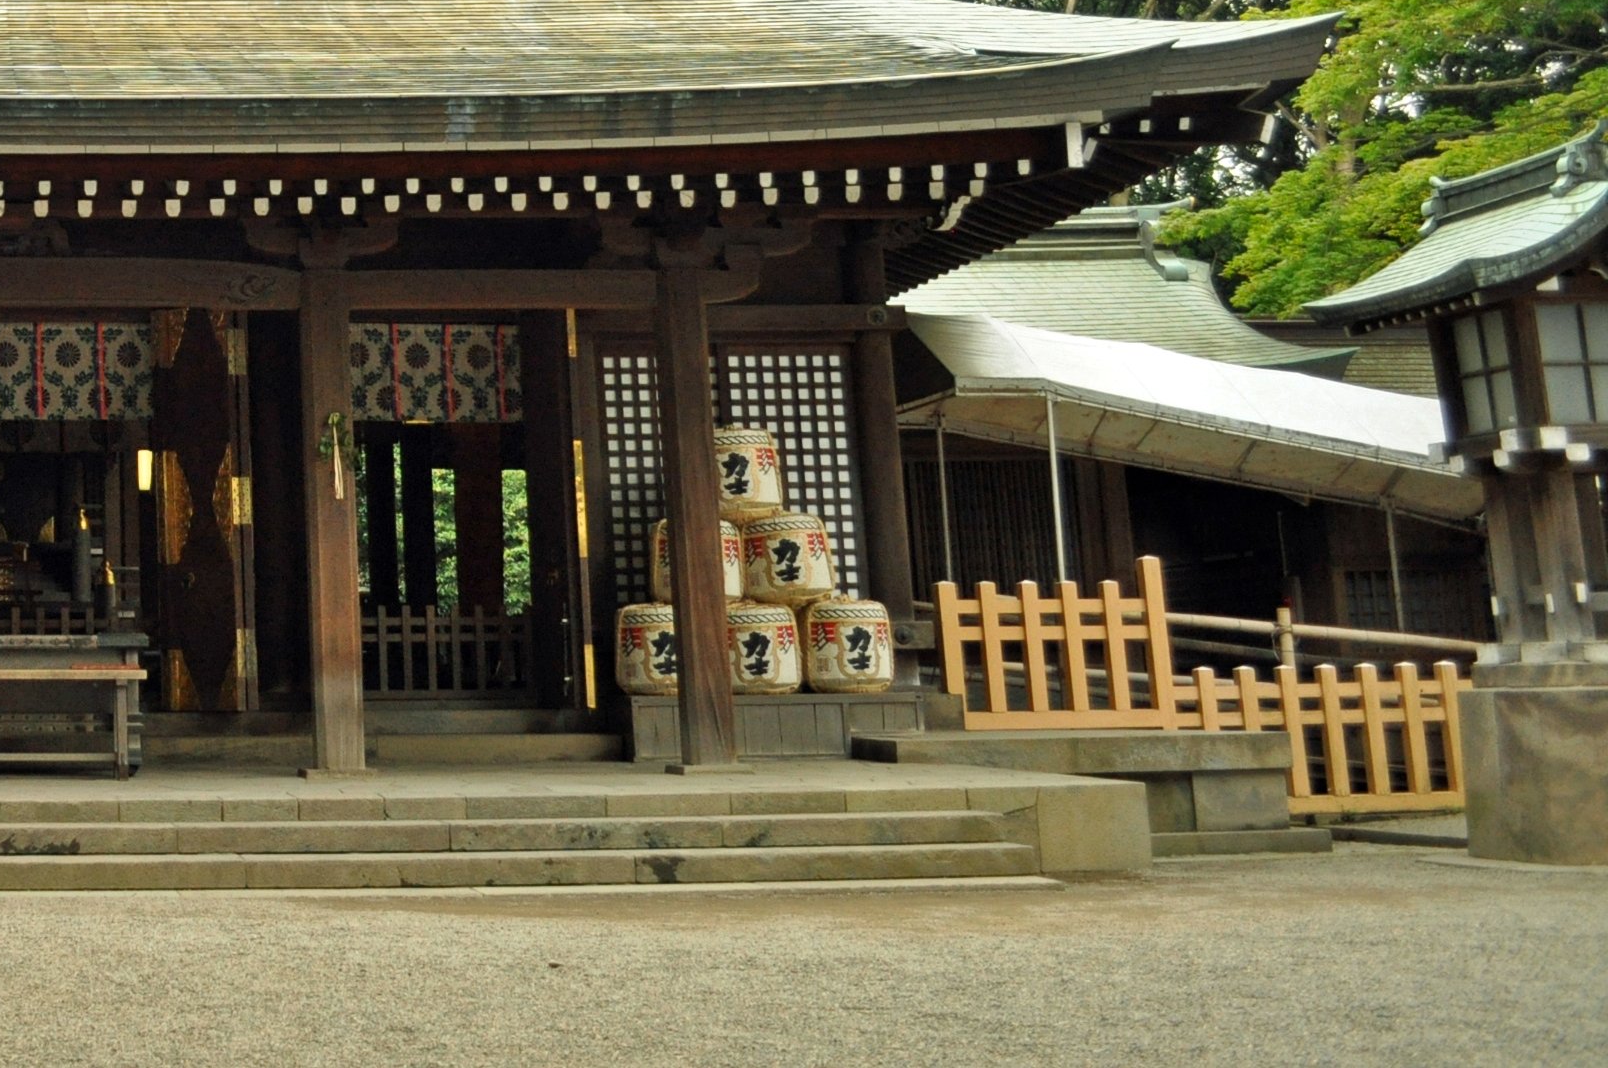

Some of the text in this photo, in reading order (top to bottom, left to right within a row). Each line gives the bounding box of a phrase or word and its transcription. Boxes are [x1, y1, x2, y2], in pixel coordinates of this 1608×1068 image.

[721, 452, 750, 495] 力士
[772, 538, 801, 582] 力士
[742, 631, 771, 676] 力士
[845, 626, 872, 670] 力士
